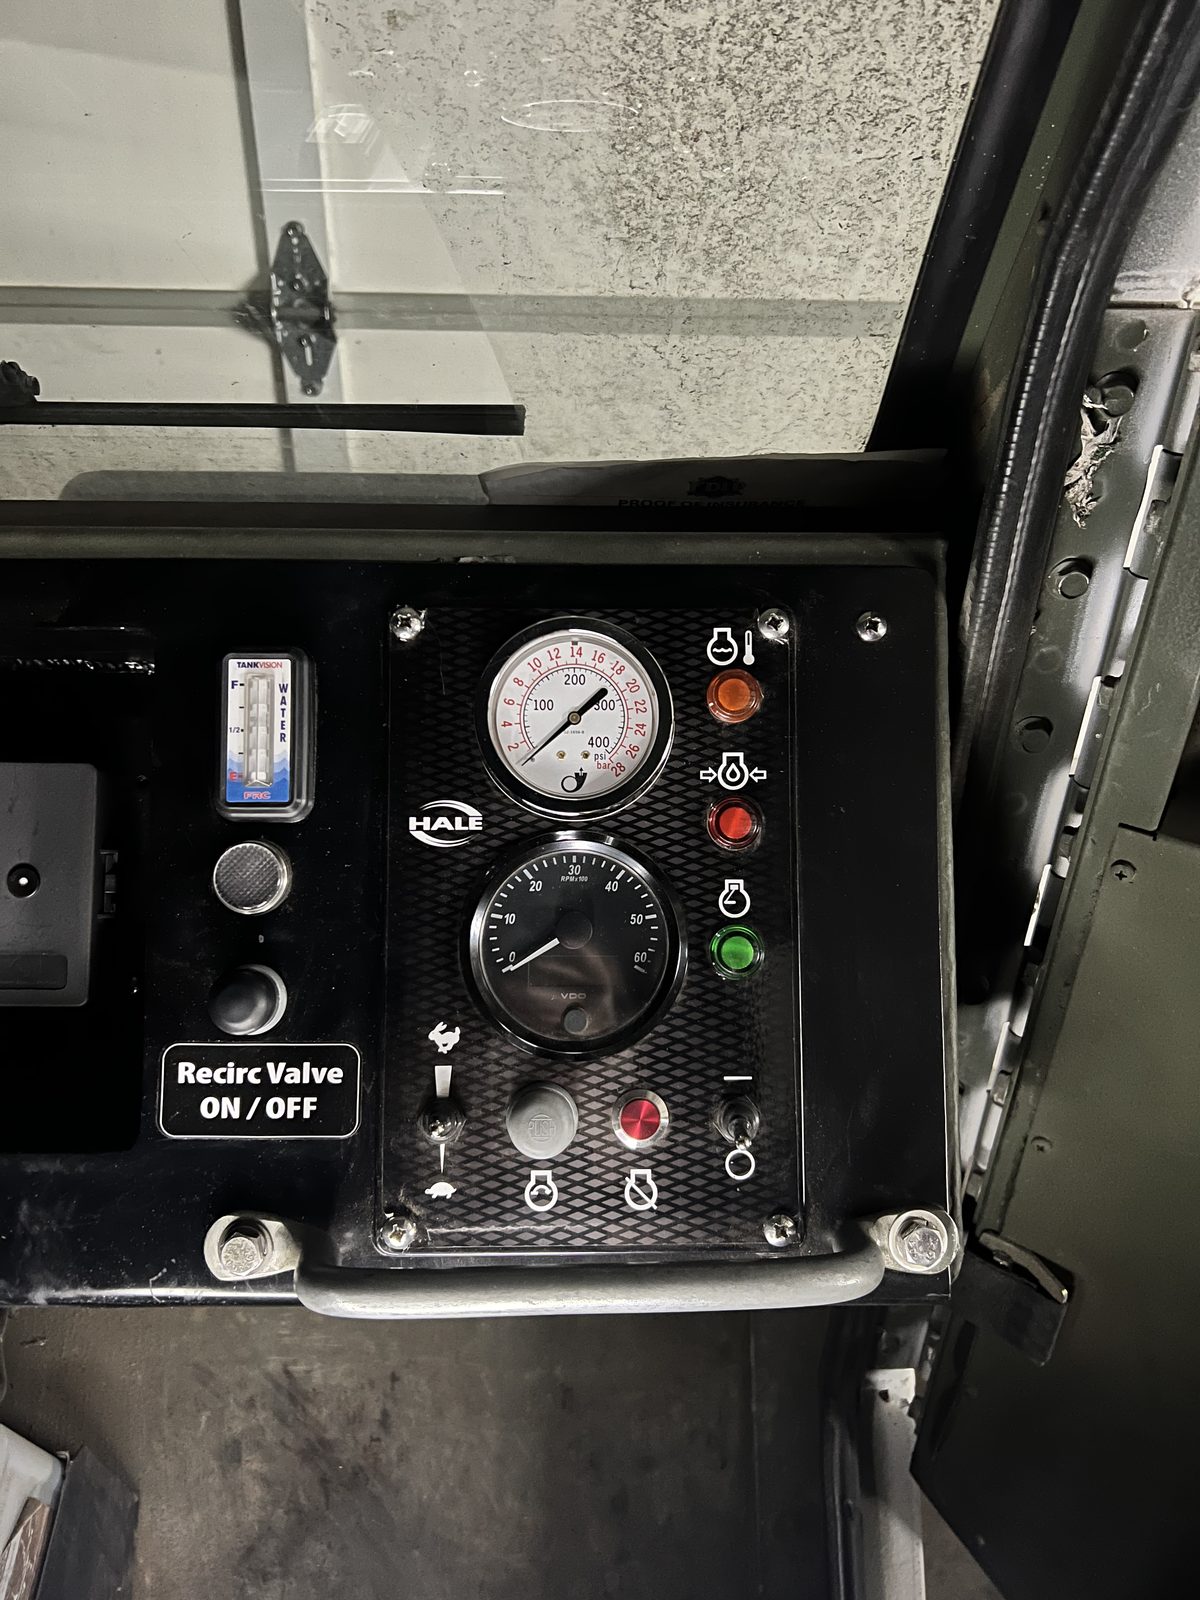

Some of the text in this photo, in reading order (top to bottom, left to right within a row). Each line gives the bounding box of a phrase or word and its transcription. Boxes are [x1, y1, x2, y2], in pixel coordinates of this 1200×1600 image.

[618, 499, 676, 509] PROOF
[547, 648, 562, 661] 12
[570, 646, 583, 658] 14
[591, 650, 606, 663] 16
[528, 658, 542, 672] 10
[611, 660, 626, 675] 18
[231, 681, 238, 689] F
[514, 677, 524, 686] 8
[564, 674, 586, 686] 200
[626, 678, 640, 693] 20
[504, 698, 515, 706] 6
[534, 700, 554, 711] 100
[594, 700, 616, 711] 300
[634, 700, 647, 714] 22
[278, 684, 288, 743] WATER
[501, 720, 513, 728] 4
[634, 722, 646, 737] 24
[508, 742, 519, 751] 2
[588, 736, 610, 748] 400
[594, 752, 606, 761] psi
[626, 744, 640, 759] 26
[596, 761, 610, 770] bar
[611, 762, 626, 777] 28
[230, 772, 239, 780] E
[409, 817, 483, 830] HALE
[568, 864, 581, 875] 30
[529, 881, 542, 892] 20
[605, 881, 618, 892] 40
[504, 913, 516, 925] 10
[630, 914, 643, 925] 50
[508, 951, 516, 962] 0
[634, 952, 647, 963] 60
[178, 1062, 344, 1084] Recirc Valve
[200, 1097, 317, 1120] ON / OFF
